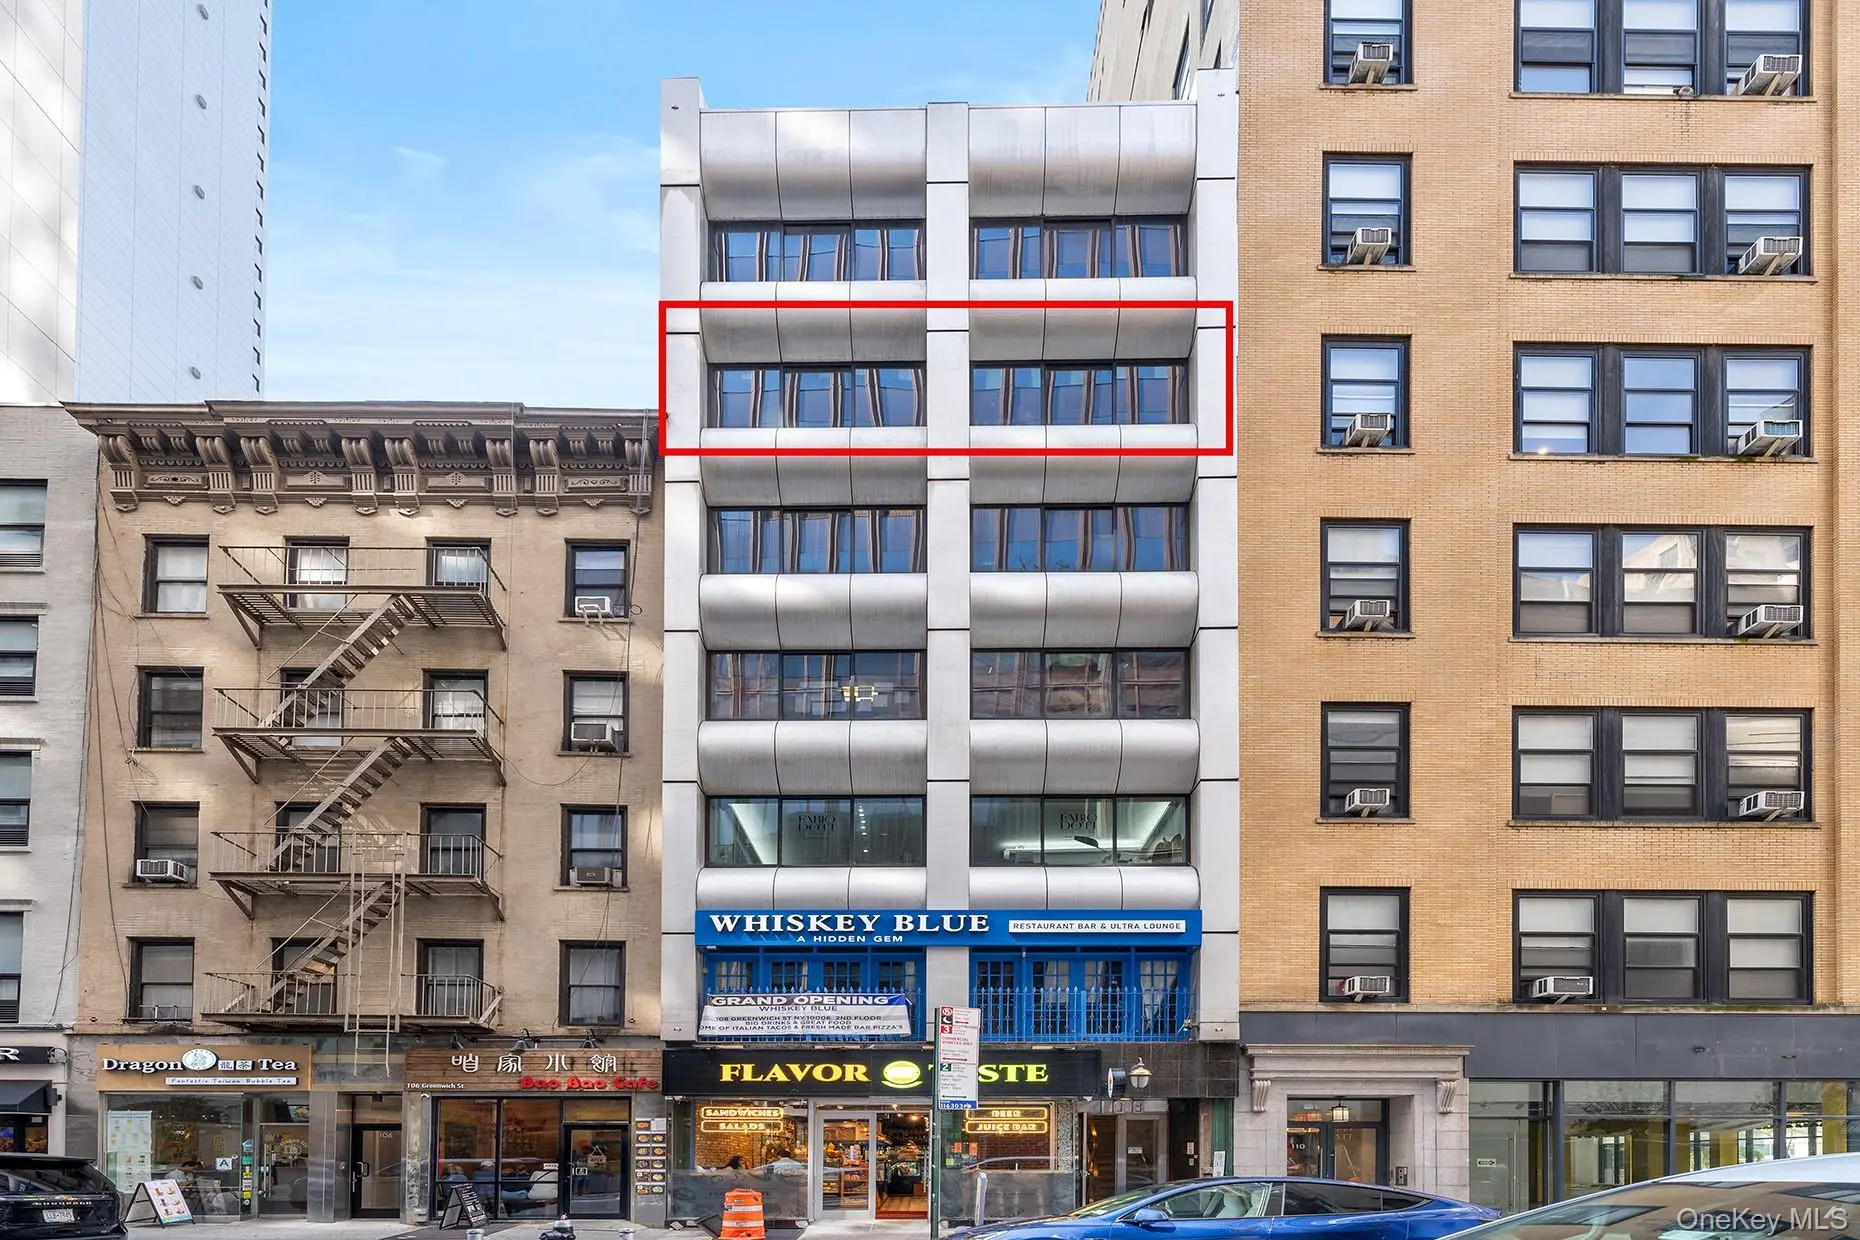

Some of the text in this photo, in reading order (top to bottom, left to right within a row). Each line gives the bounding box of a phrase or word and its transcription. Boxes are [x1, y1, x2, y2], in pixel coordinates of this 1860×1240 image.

[709, 914, 989, 932] WHISKEY BLUE
[1013, 922, 1181, 930] RESTAURANT BAR & ULTRA LOUNGE
[796, 935, 903, 943] A HIDDEN GEM
[712, 996, 889, 1006] GRAND OPENING
[103, 1059, 184, 1074] Dragon
[258, 1058, 297, 1071] Tea
[720, 1065, 870, 1082] FLAVOR
[520, 1075, 658, 1090] Bao Bao Cafe
[705, 1109, 780, 1117] SANDWICHES
[991, 1110, 1022, 1118] BEER
[977, 1123, 1037, 1131] JUICE BAR
